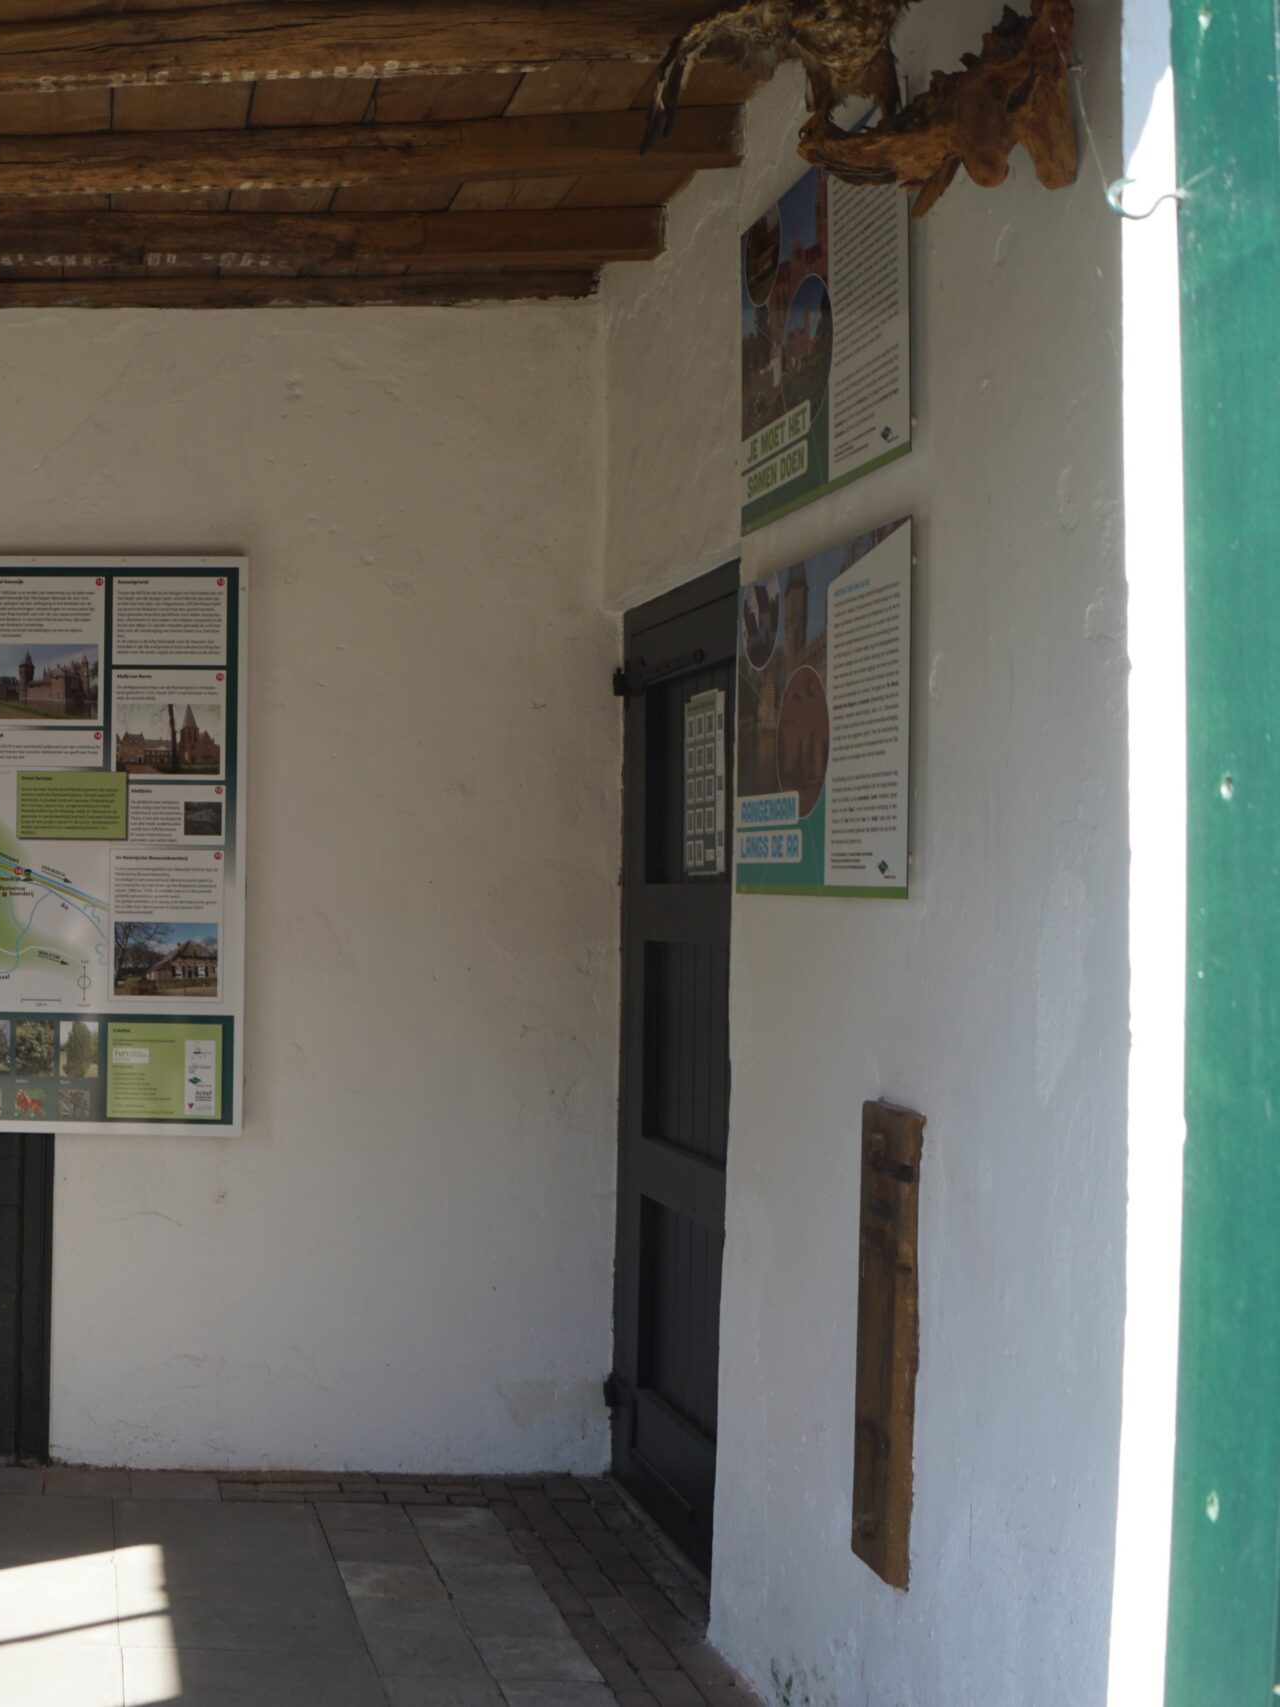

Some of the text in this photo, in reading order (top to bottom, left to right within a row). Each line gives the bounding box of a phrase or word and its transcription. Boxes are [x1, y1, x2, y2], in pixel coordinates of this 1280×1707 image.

[748, 406, 808, 464] JE MOET HET
[747, 445, 805, 499] SAMEN DOEN
[741, 796, 797, 823] AANGENAAM
[741, 833, 799, 859] LANGS DE AA
